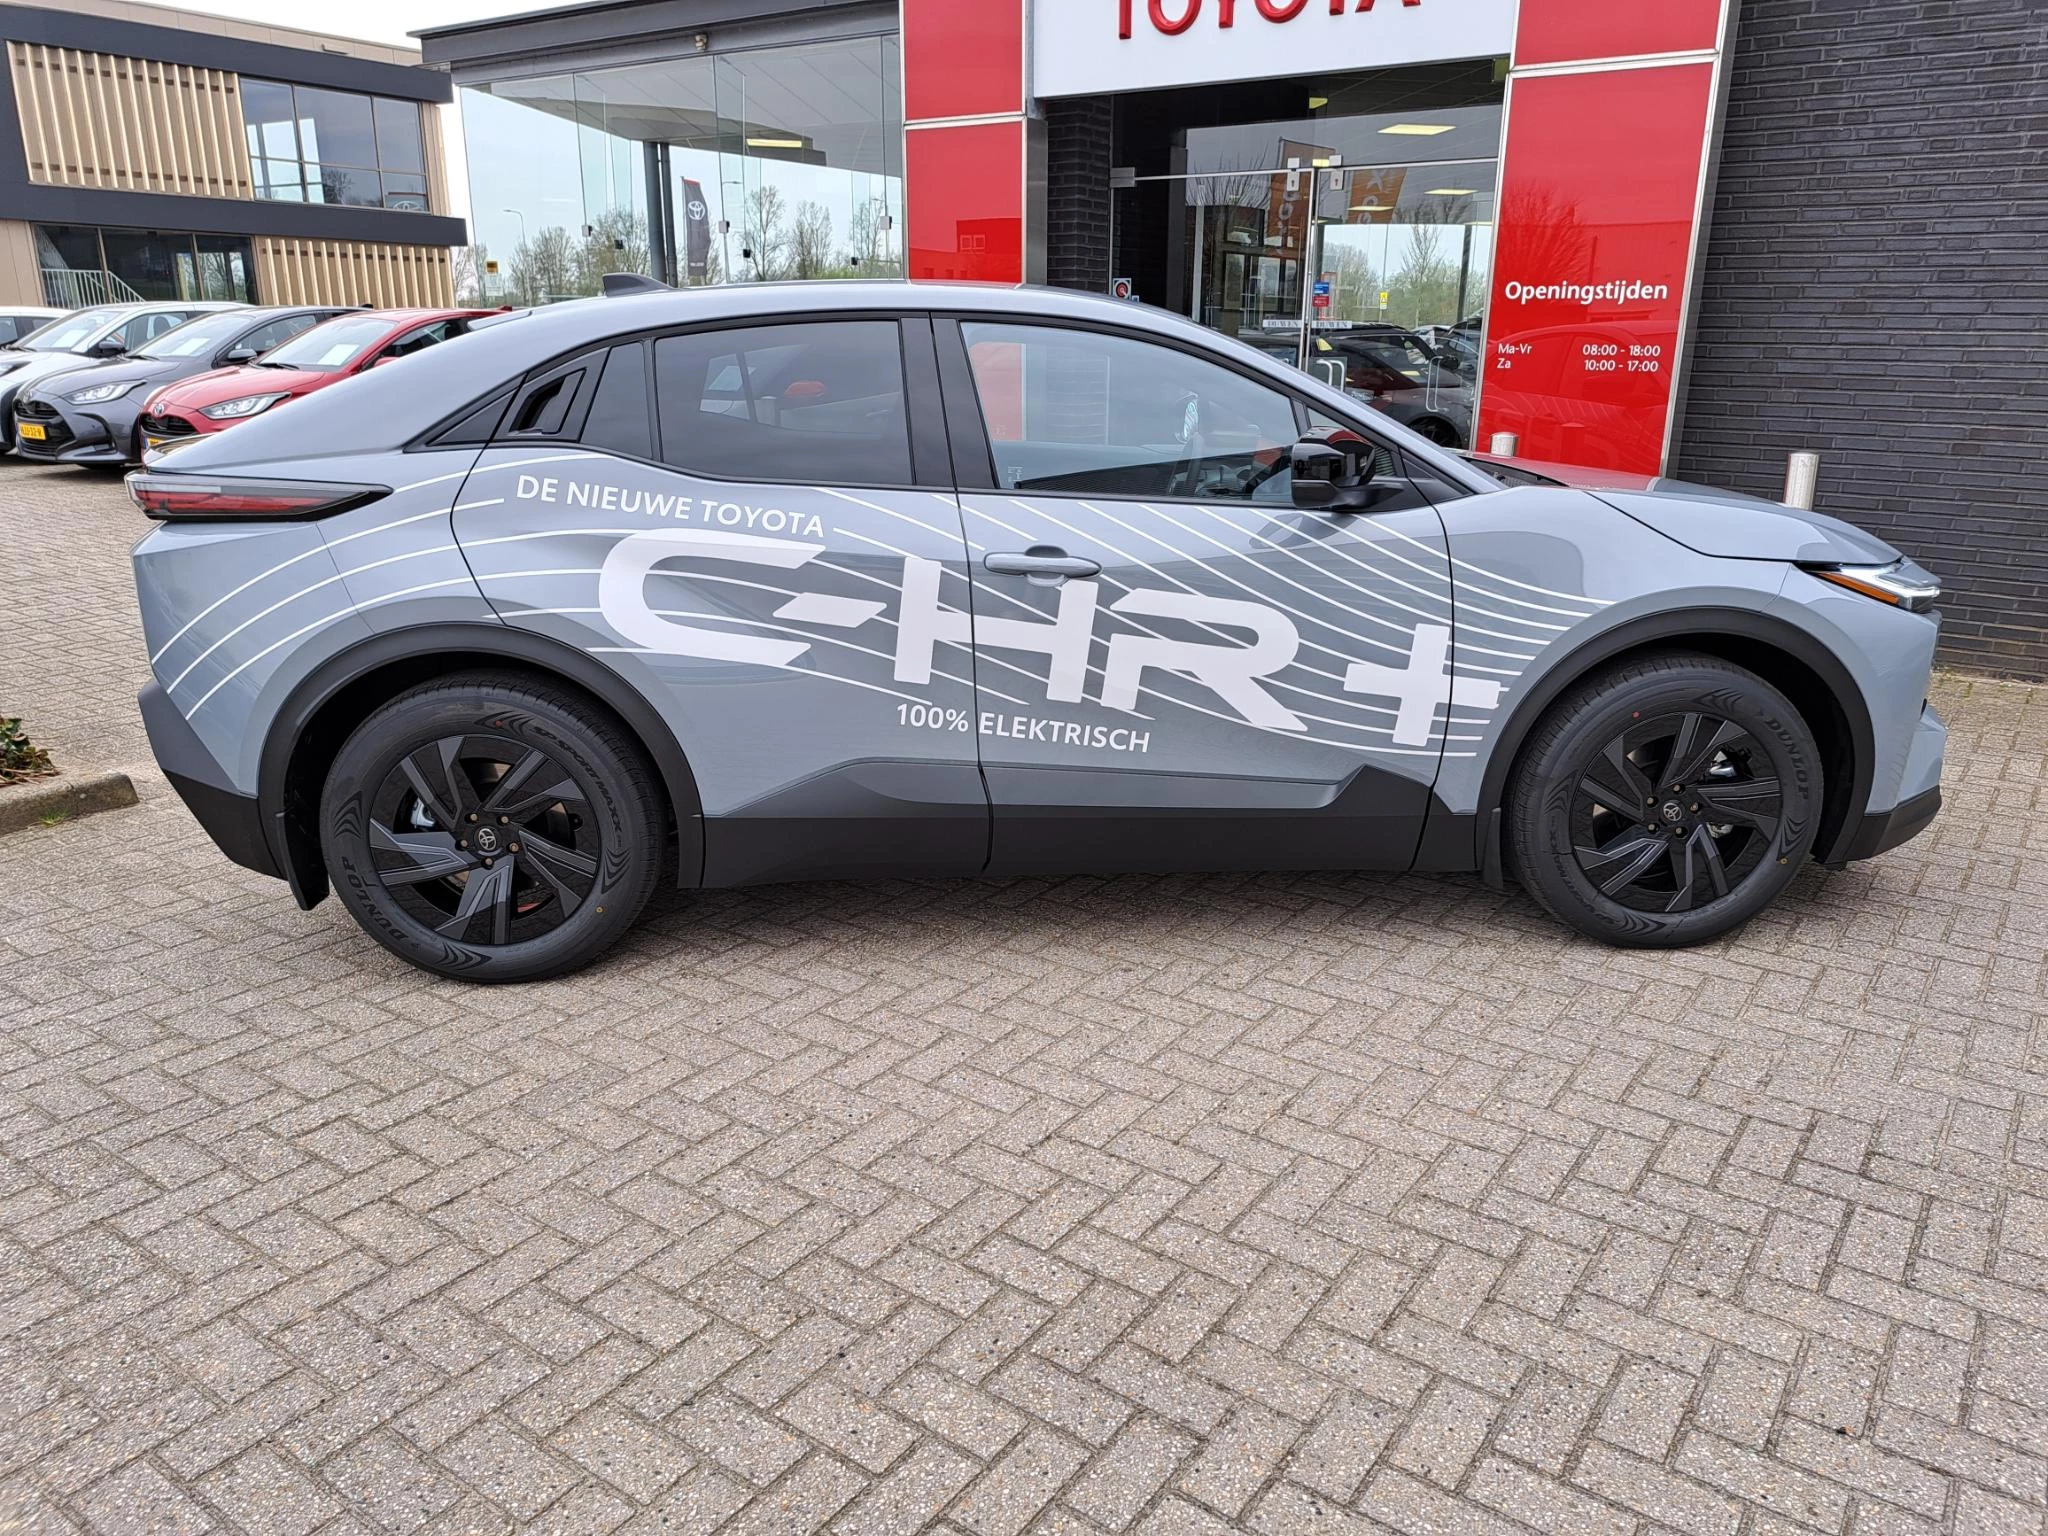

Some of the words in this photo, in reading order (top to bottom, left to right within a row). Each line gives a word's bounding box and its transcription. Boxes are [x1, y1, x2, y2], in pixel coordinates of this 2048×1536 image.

[1505, 280, 1668, 305] Openingstijden
[1496, 357, 1511, 369] Za
[1584, 360, 1616, 371] 10:00
[1627, 360, 1659, 372] 17:00
[1497, 343, 1532, 355] Ma-Vr
[1582, 344, 1617, 357] 08:00
[1628, 345, 1661, 357] 18:00
[516, 474, 559, 503] DE
[566, 481, 694, 520] NIEUWE
[700, 499, 826, 538] TOYOTA
[598, 527, 1502, 747] C-HR+
[896, 703, 970, 733] 100%
[978, 711, 1152, 754] ELEKTRISCH
[1764, 717, 1809, 800] DUNLOP
[341, 855, 409, 941] DUNLOP
